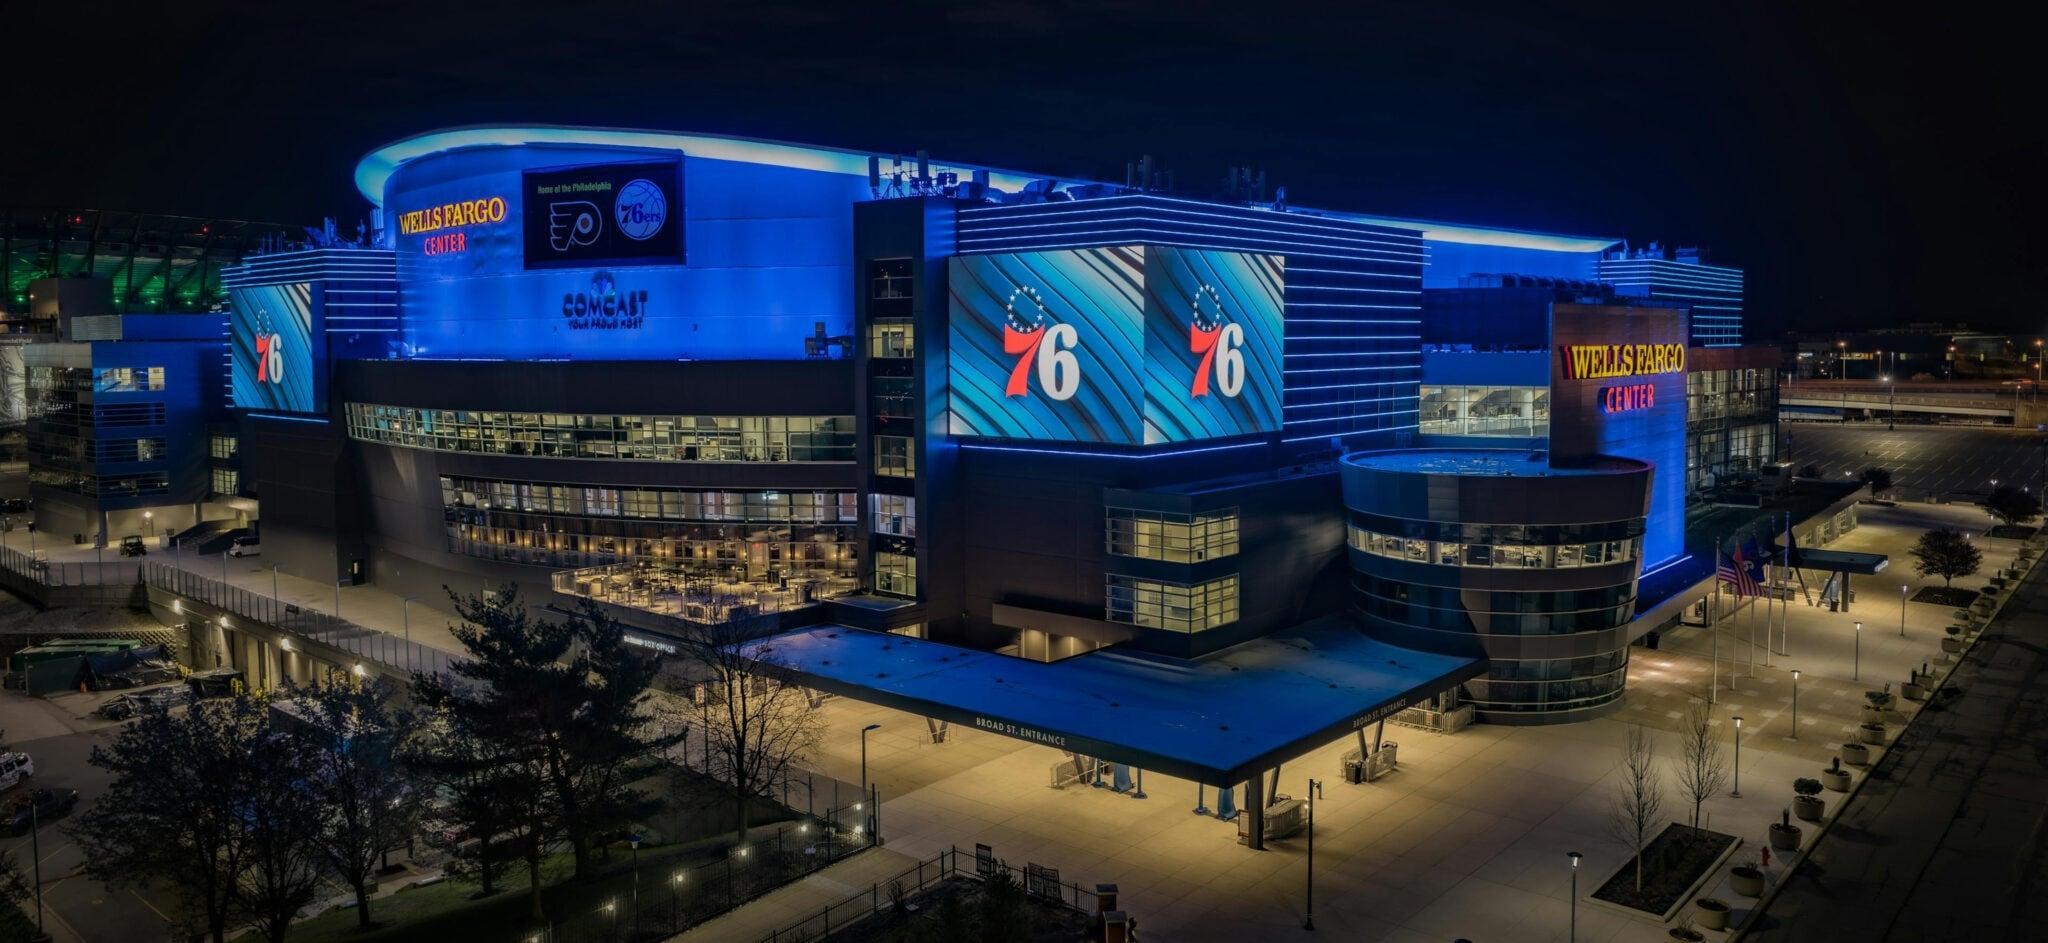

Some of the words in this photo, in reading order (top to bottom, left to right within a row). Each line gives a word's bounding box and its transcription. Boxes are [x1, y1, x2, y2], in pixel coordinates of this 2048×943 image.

[538, 185, 554, 195] Home
[555, 185, 561, 193] of
[562, 183, 572, 192] the
[573, 181, 612, 192] Philadelphia
[400, 205, 445, 235] WELLS
[445, 197, 505, 227] FARGO
[621, 202, 661, 225] 76ers
[424, 233, 466, 256] CENTER
[563, 290, 648, 318] COMCAST
[569, 319, 589, 330] YOUR
[591, 319, 619, 330] PROUD
[620, 317, 643, 330] HOST
[256, 333, 284, 384] 76
[1004, 322, 1080, 400] 76
[1190, 322, 1245, 400] 76
[1571, 344, 1634, 379] WELLS
[1636, 343, 1685, 375] FARGO
[1605, 384, 1655, 413] CENTER
[1353, 713, 1372, 729] BROAD
[1381, 697, 1406, 717] ENTRANCE
[976, 717, 1004, 731] BROAD
[1006, 724, 1018, 735] ST.
[1021, 727, 1066, 746] ENTRANCE
